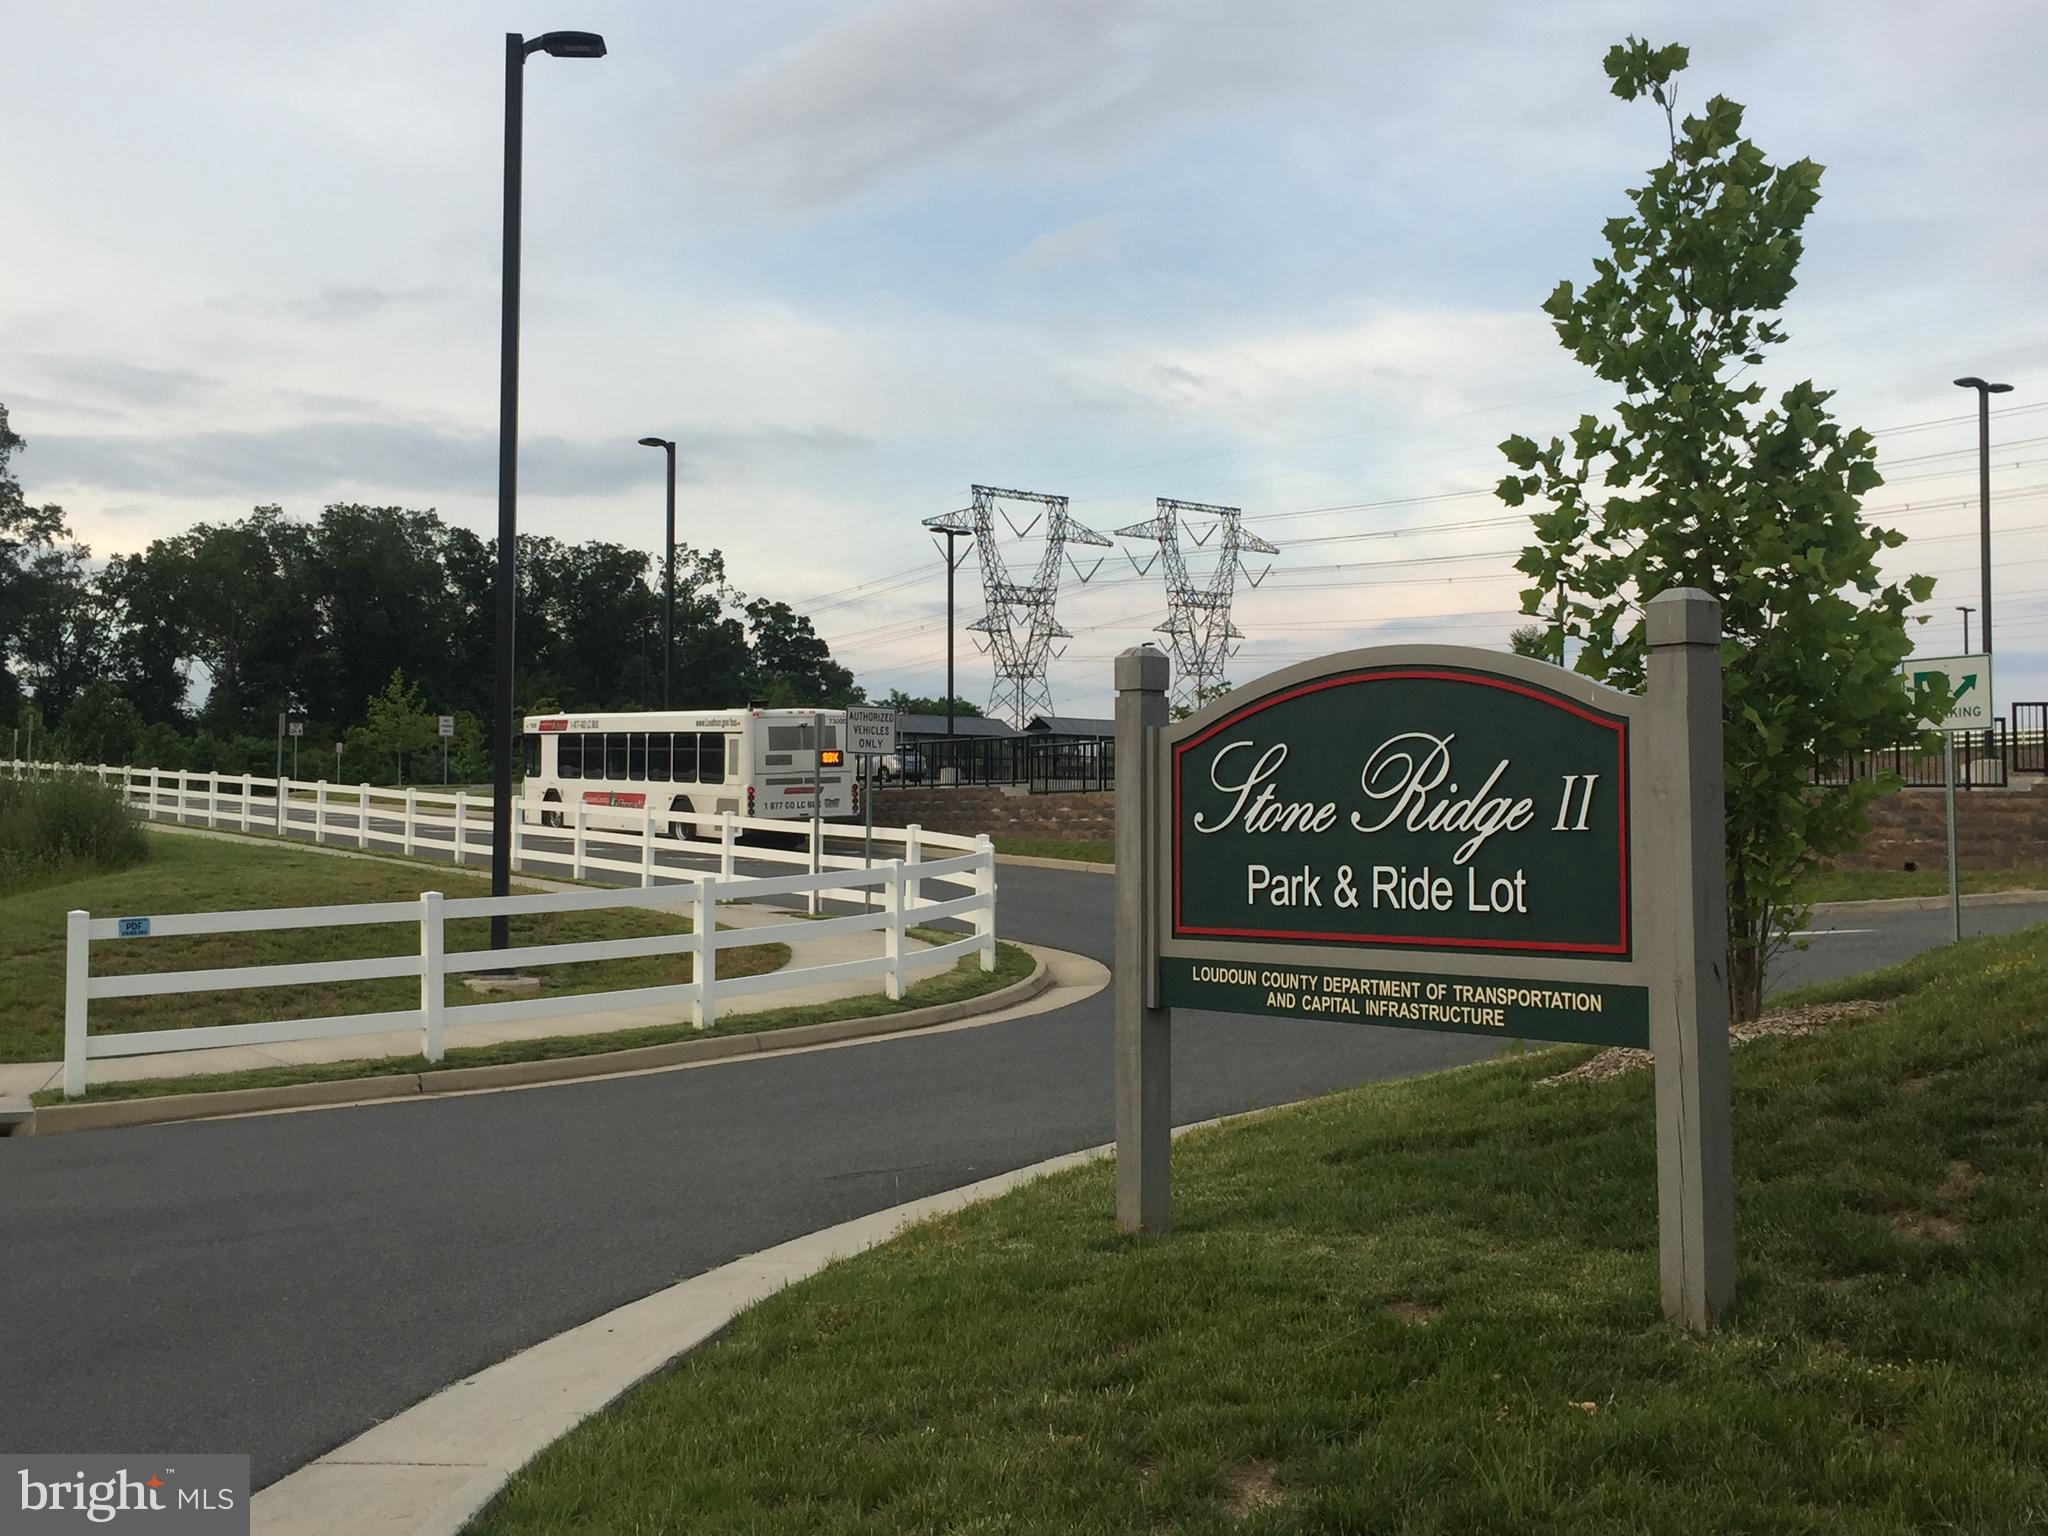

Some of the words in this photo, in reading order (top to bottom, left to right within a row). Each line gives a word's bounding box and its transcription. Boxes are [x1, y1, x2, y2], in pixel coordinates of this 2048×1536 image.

[849, 711, 894, 723] AUTHORIZED
[1940, 705, 1982, 719] KING
[853, 724, 890, 736] VEHICLES
[858, 738, 884, 749] ONLY
[770, 801, 783, 810] 877
[784, 800, 796, 810] GO
[796, 800, 806, 809] LC
[1194, 740, 1337, 834] Stone
[1350, 732, 1535, 865] Ridge
[1551, 773, 1601, 832] II
[1246, 863, 1323, 908] Park
[1333, 864, 1360, 908] &
[1371, 864, 1454, 911] Ride
[1467, 866, 1528, 914] Lot
[1191, 965, 1257, 986] LOUDOUN
[1261, 970, 1319, 992] COUNTY
[1322, 975, 1421, 999] DEPARTMENT
[1425, 982, 1448, 1001] OF
[1452, 984, 1603, 1013] TRANSPORTATION
[1265, 991, 1297, 1010] AND
[1300, 994, 1361, 1015] CAPITAL
[1364, 999, 1506, 1027] INFRASTRUCTURE
